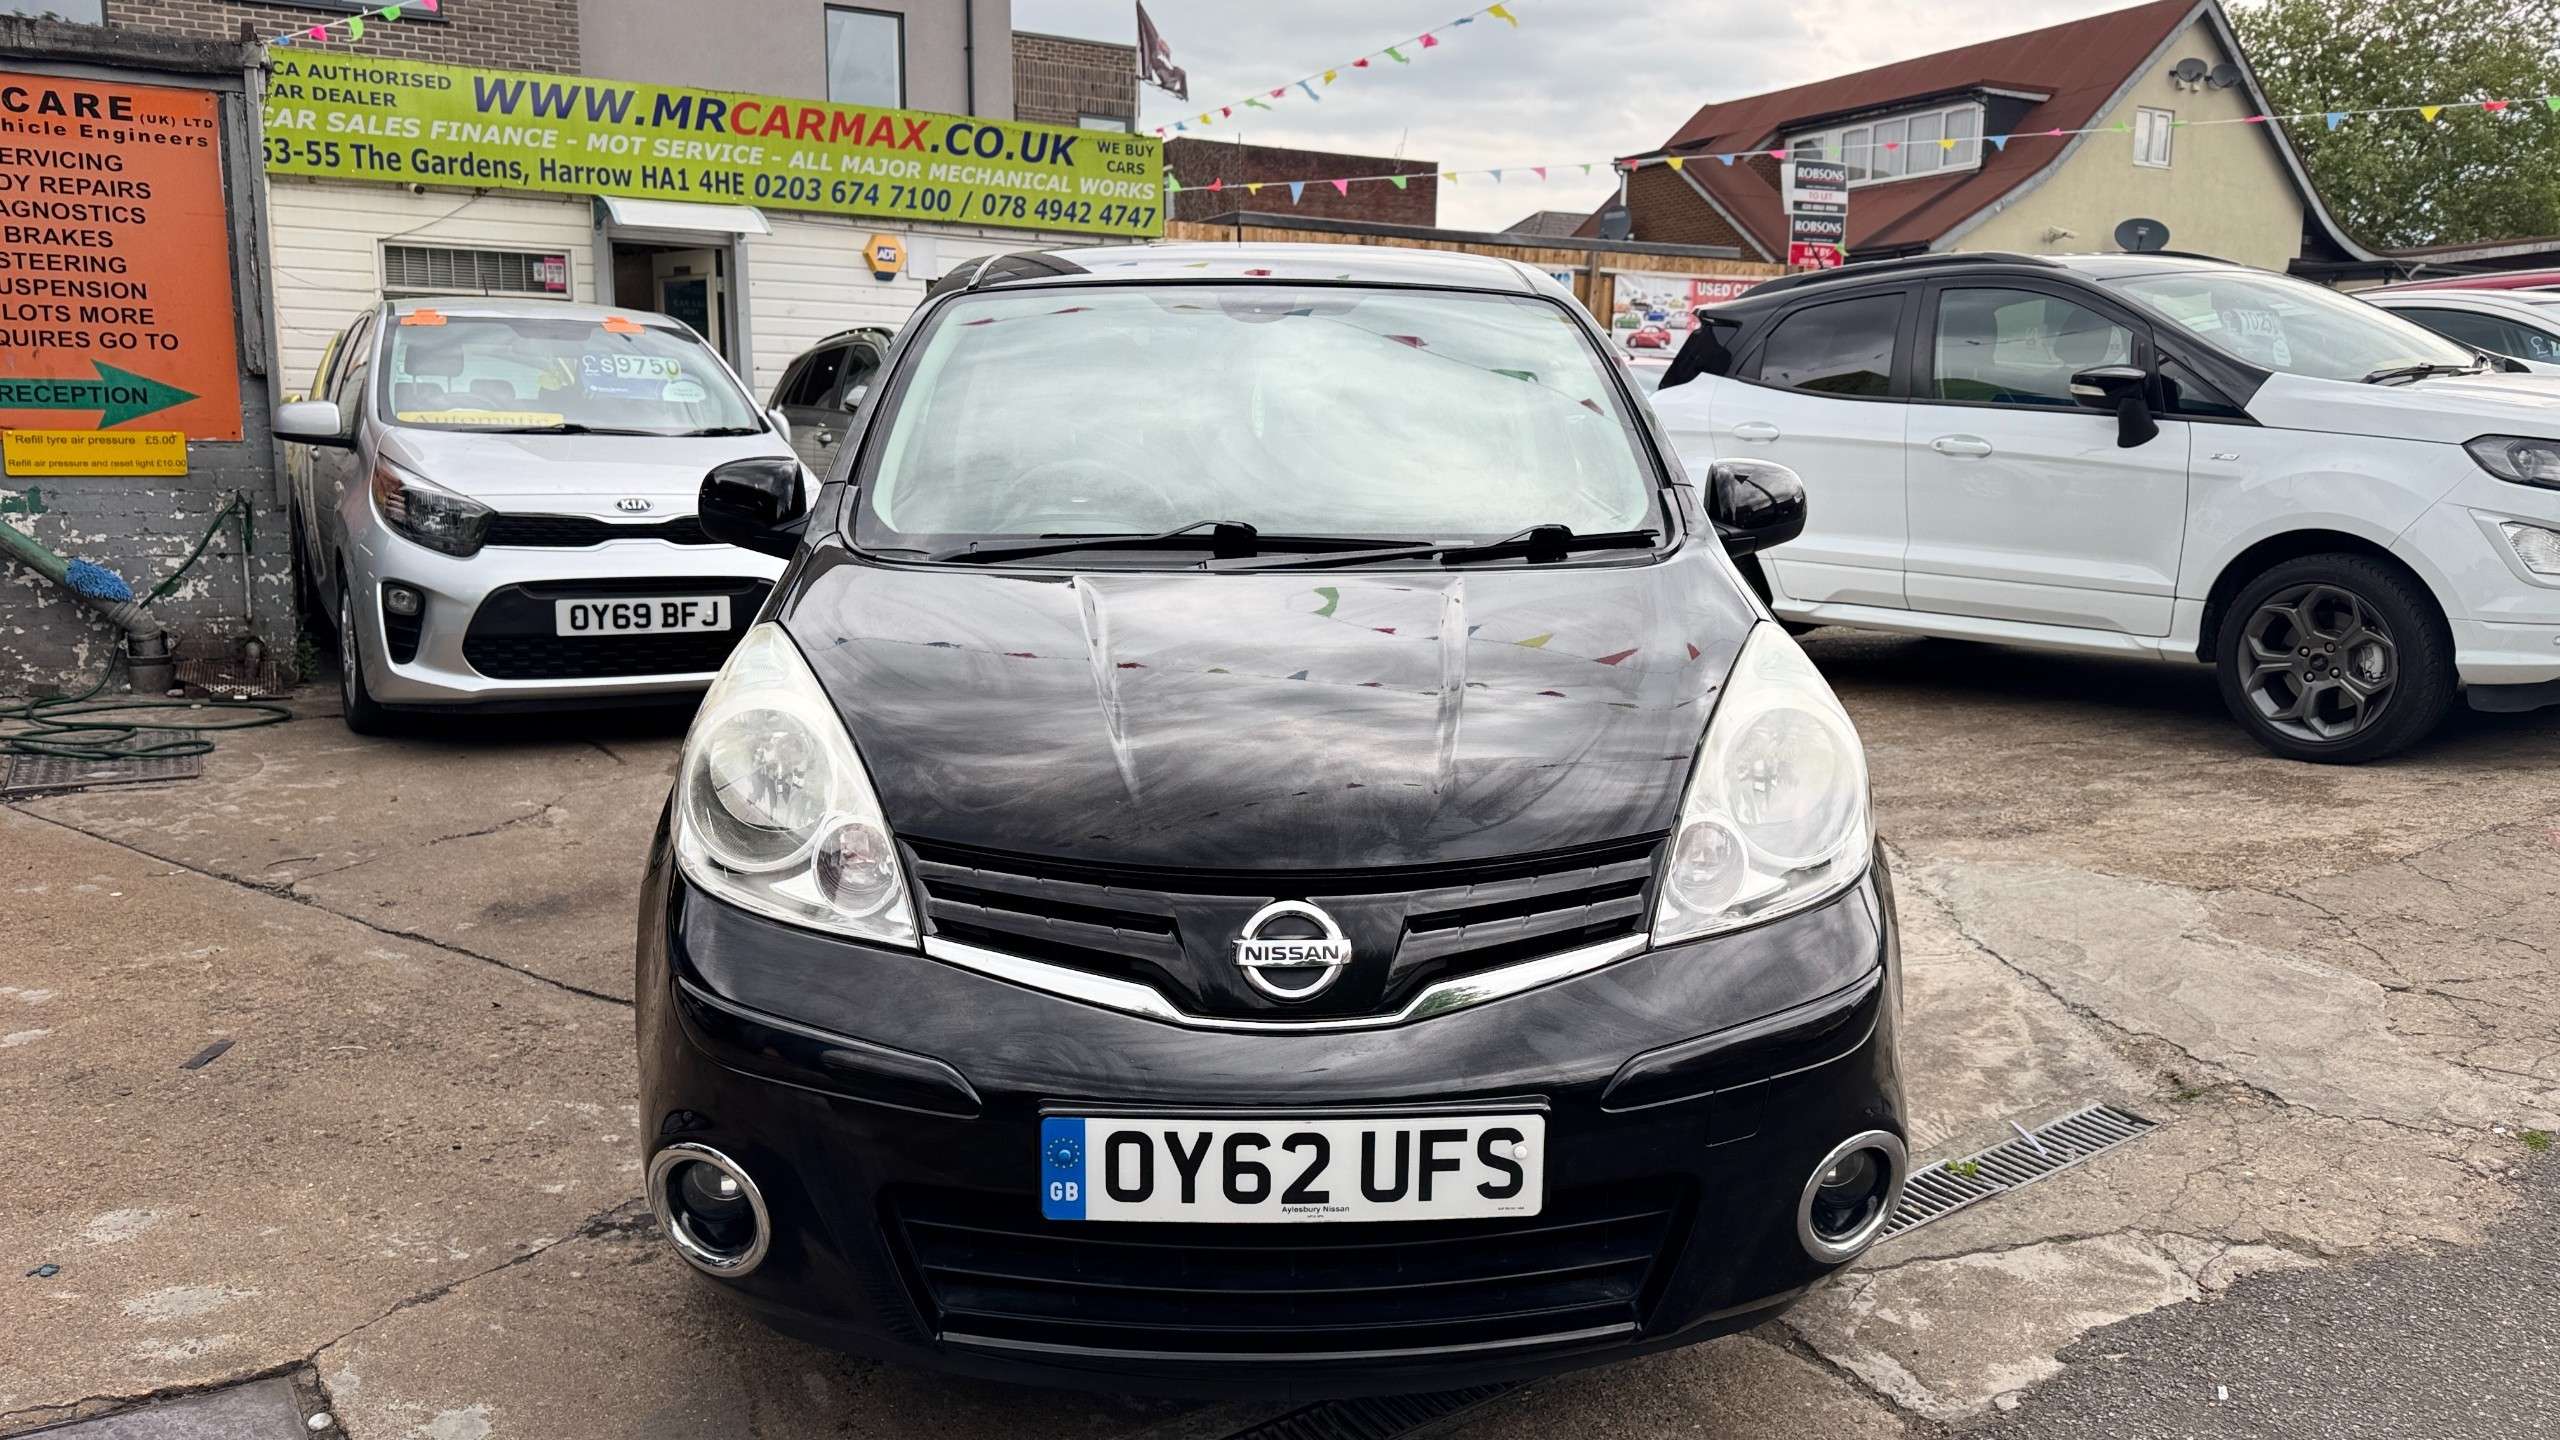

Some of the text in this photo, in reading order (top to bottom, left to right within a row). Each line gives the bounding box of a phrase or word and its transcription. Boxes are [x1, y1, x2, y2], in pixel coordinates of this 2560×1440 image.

[308, 64, 452, 90] AUTHORISED
[312, 86, 397, 107] DEALER
[1, 86, 213, 128] CARE (UK) LTD
[473, 76, 1079, 167] WWW.MRCARMAX.CO.UK
[80, 124, 208, 147] Engineers
[326, 112, 421, 138] SALES
[430, 120, 558, 149] FINANCE
[587, 134, 647, 155] MOT
[653, 138, 765, 165] SERVICE
[789, 151, 832, 171] ALL
[840, 153, 921, 179] MAJOR
[928, 163, 1071, 194] MECHANICAL
[1080, 176, 1156, 199] WORKS
[1097, 141, 1155, 157] WE BUY
[1107, 160, 1145, 175] CARS
[1797, 167, 1845, 181] ROBSONS
[40, 176, 151, 199] REPAIRS
[350, 144, 402, 171] The
[411, 149, 530, 186] Gardens,
[540, 158, 632, 187] Harrow
[642, 165, 690, 191] HA1
[699, 171, 744, 195] 4HE
[755, 173, 822, 203] 0203
[831, 180, 880, 208] 674
[889, 185, 951, 212] 7100
[982, 194, 1026, 219] 078
[1034, 199, 1091, 224] 4942
[1099, 204, 1156, 229] 4747
[1808, 191, 1834, 200] TO LET
[4, 226, 113, 247] BRAKES
[1794, 220, 1842, 234] ROBSONS
[0, 252, 127, 273] STEERING
[878, 248, 896, 260] ADT
[1697, 281, 1731, 297] USED
[3, 304, 155, 324] LOTS MORE
[99, 332, 137, 349] GO
[145, 333, 178, 350] TO
[0, 385, 148, 404] RECEPTION
[15, 434, 176, 448] Refill tyre air pressure £5.00
[8, 458, 32, 468] Refill
[34, 459, 46, 467] air
[48, 460, 89, 470] pressure
[91, 458, 107, 468] and
[110, 459, 133, 468] reset
[135, 458, 154, 470] light
[620, 499, 649, 511] KIA
[570, 601, 719, 631] OY69 BFJ
[1244, 944, 1340, 963] NISSAN
[1105, 1127, 1525, 1205] OY62 UFS
[1049, 1181, 1079, 1202] GB
[1282, 1206, 1321, 1215] Aylesbury
